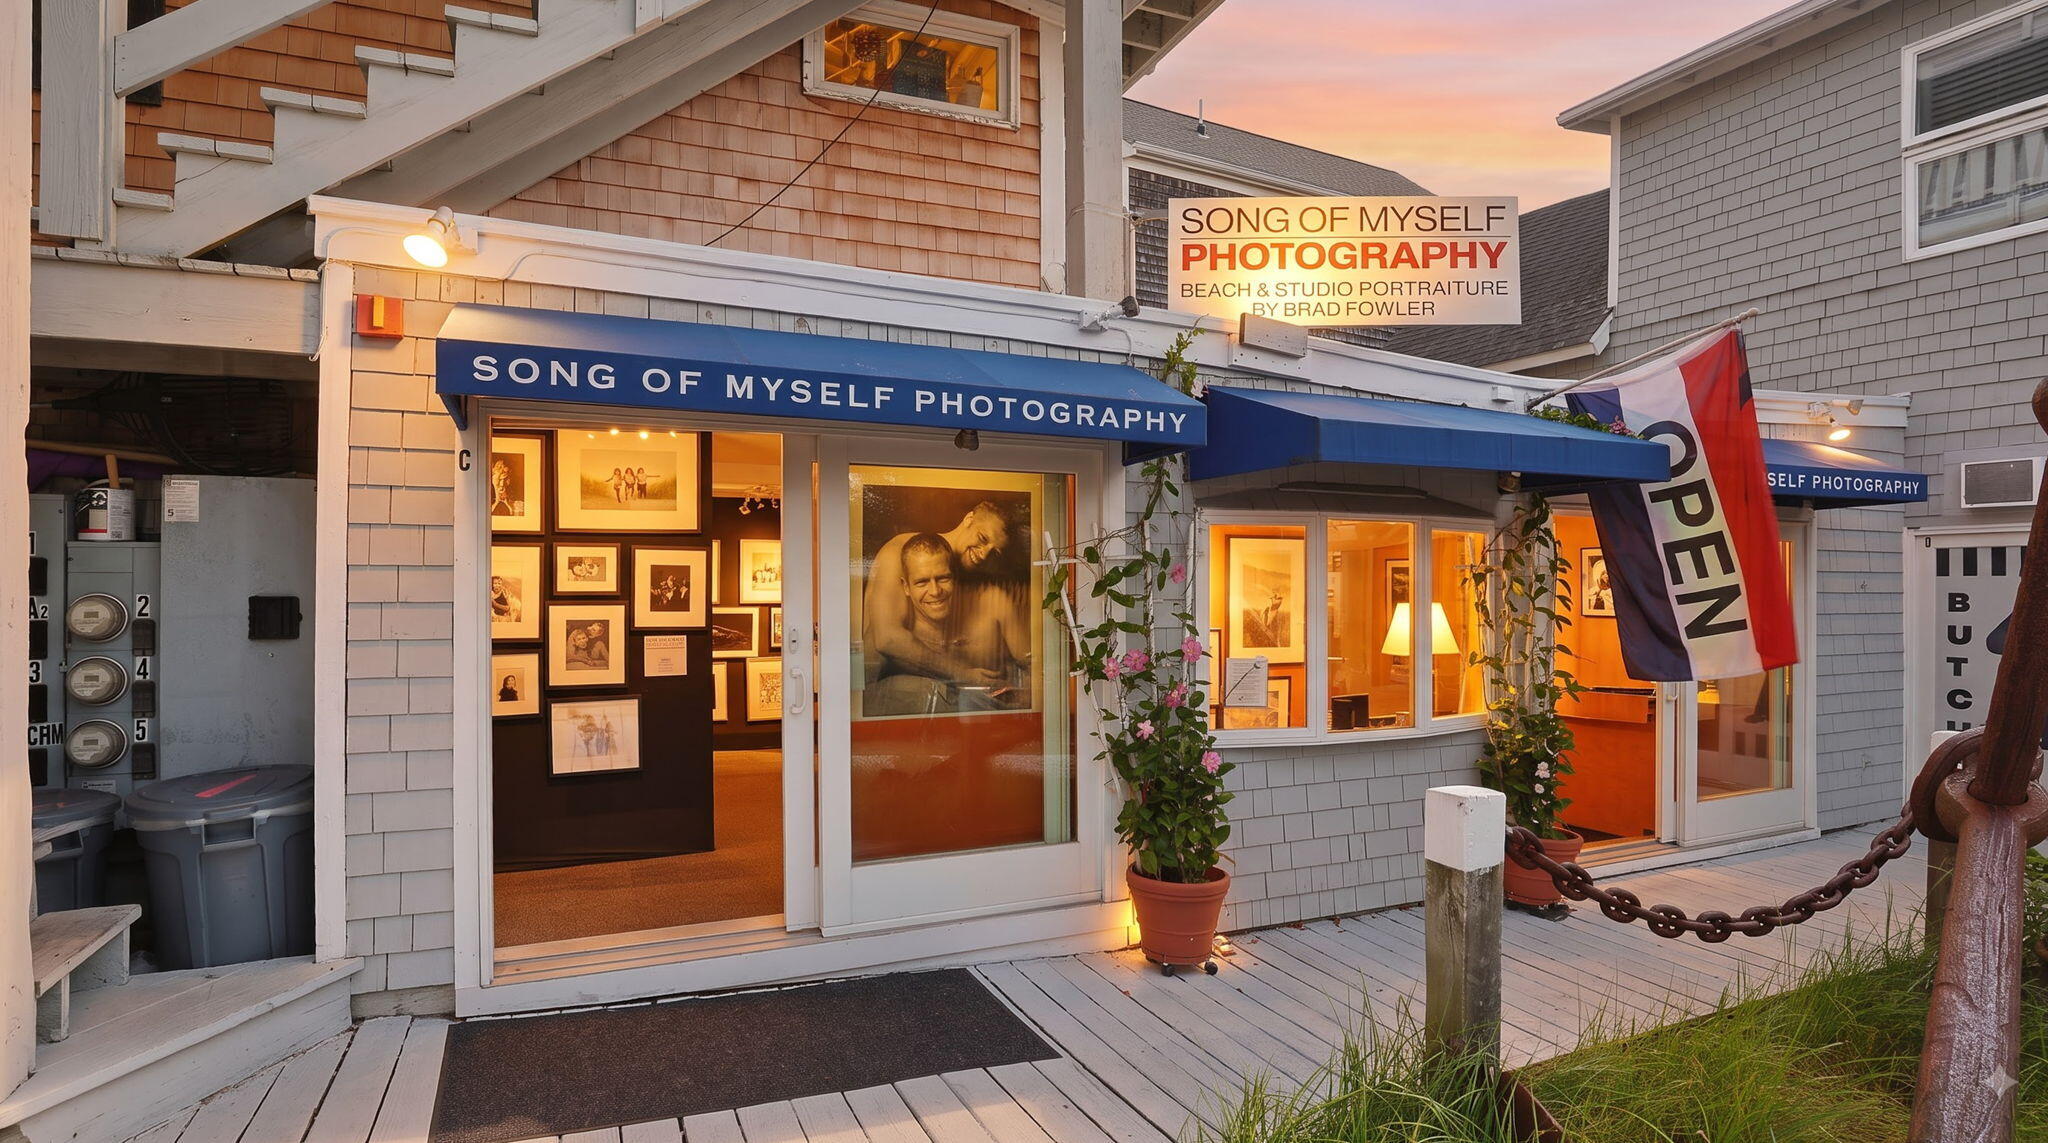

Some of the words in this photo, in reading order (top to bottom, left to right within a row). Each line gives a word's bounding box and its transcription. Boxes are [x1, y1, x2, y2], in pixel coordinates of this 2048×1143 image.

[1181, 207, 1289, 234] SONG
[1299, 206, 1350, 233] OF
[1360, 205, 1506, 232] MYSELF
[1181, 241, 1508, 272] PHOTOGRAPHY
[1181, 282, 1251, 298] BEACH
[1256, 283, 1269, 297] &
[1275, 281, 1353, 297] STUDIO
[1359, 280, 1509, 296] PORTRAITURE
[1252, 302, 1279, 317] BY
[1284, 302, 1341, 317] BRAD
[1346, 301, 1435, 317] FOWLER
[472, 355, 616, 390] SONG
[642, 368, 702, 395] OF
[725, 374, 895, 410] MYSELF
[914, 389, 1188, 434] PHOTOGRAPHY
[458, 449, 471, 472] C
[1812, 475, 1920, 495] PHOTOGRAPHY
[1638, 420, 1748, 640] OPEN
[137, 595, 149, 617] 2
[29, 661, 41, 683] 3
[136, 658, 148, 680] 4
[135, 719, 147, 741] 5
